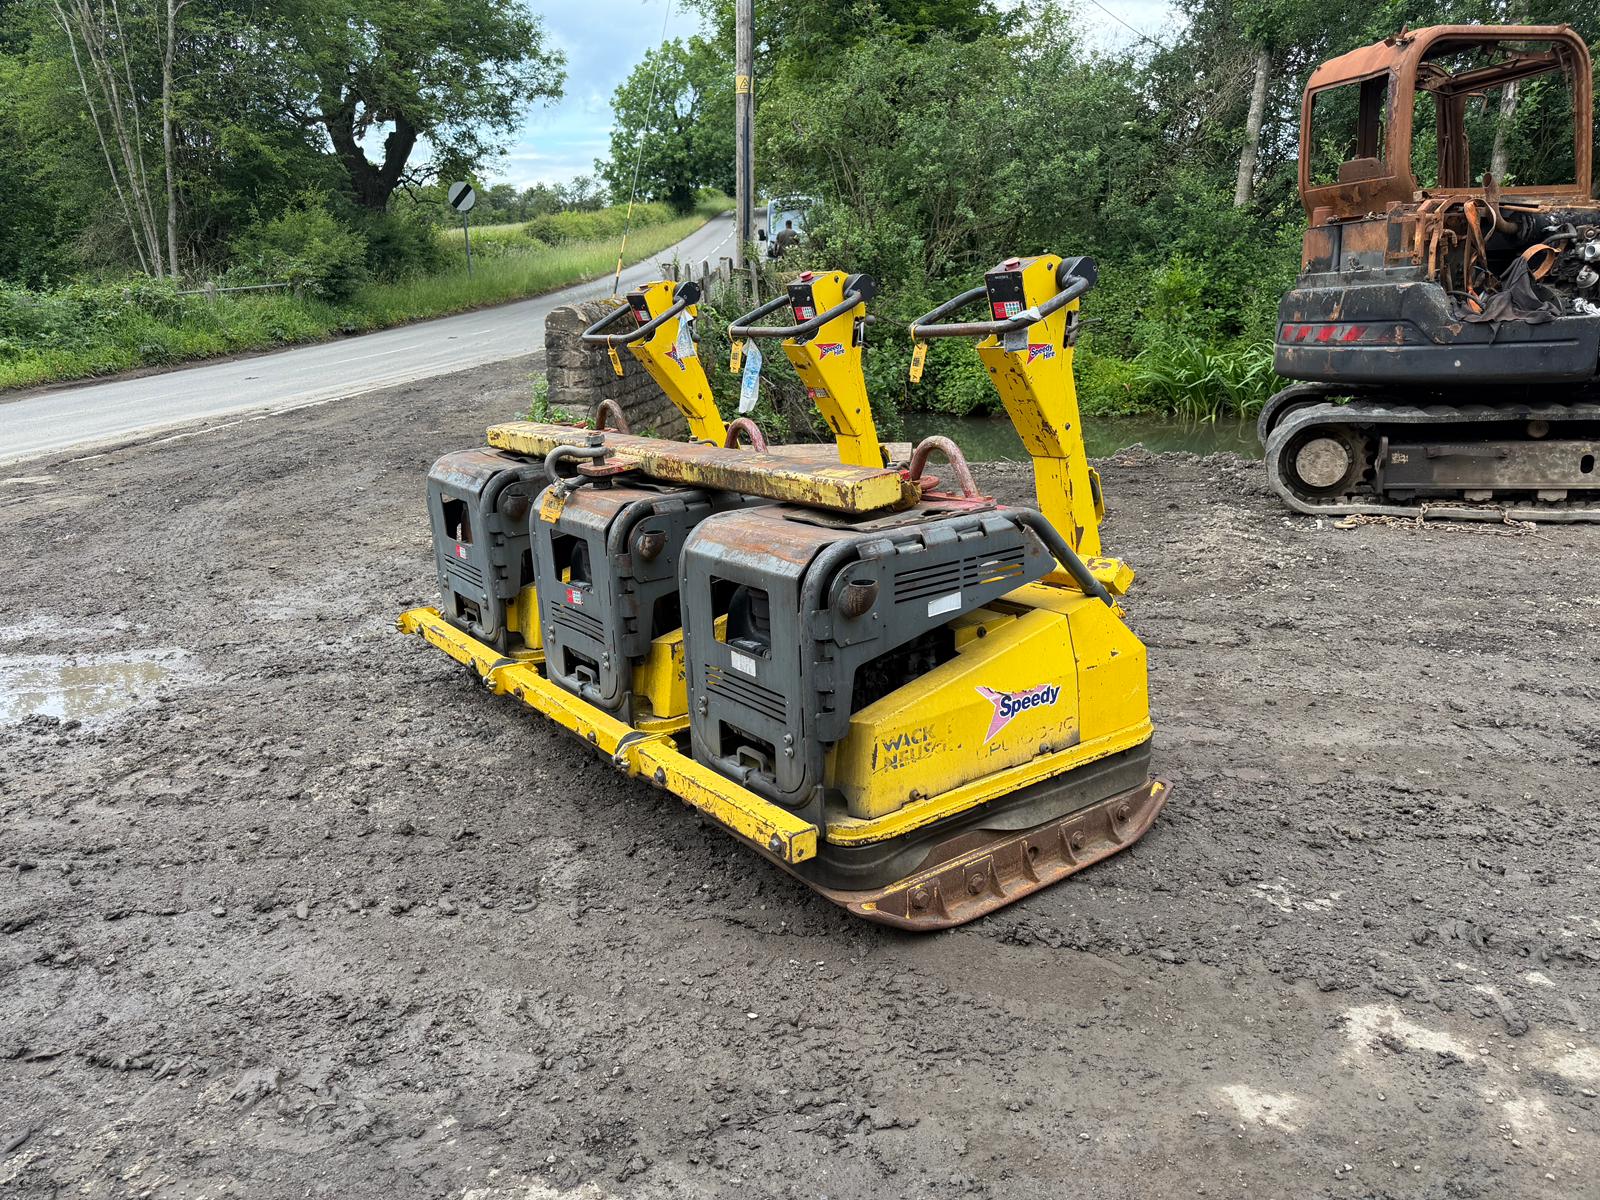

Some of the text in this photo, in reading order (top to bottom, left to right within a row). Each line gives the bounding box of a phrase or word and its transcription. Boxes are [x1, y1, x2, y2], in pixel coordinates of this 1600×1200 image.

[821, 344, 843, 355] Speedy
[1030, 344, 1054, 357] Speedy
[1043, 351, 1056, 359] Hire
[999, 685, 1061, 718] Speedy
